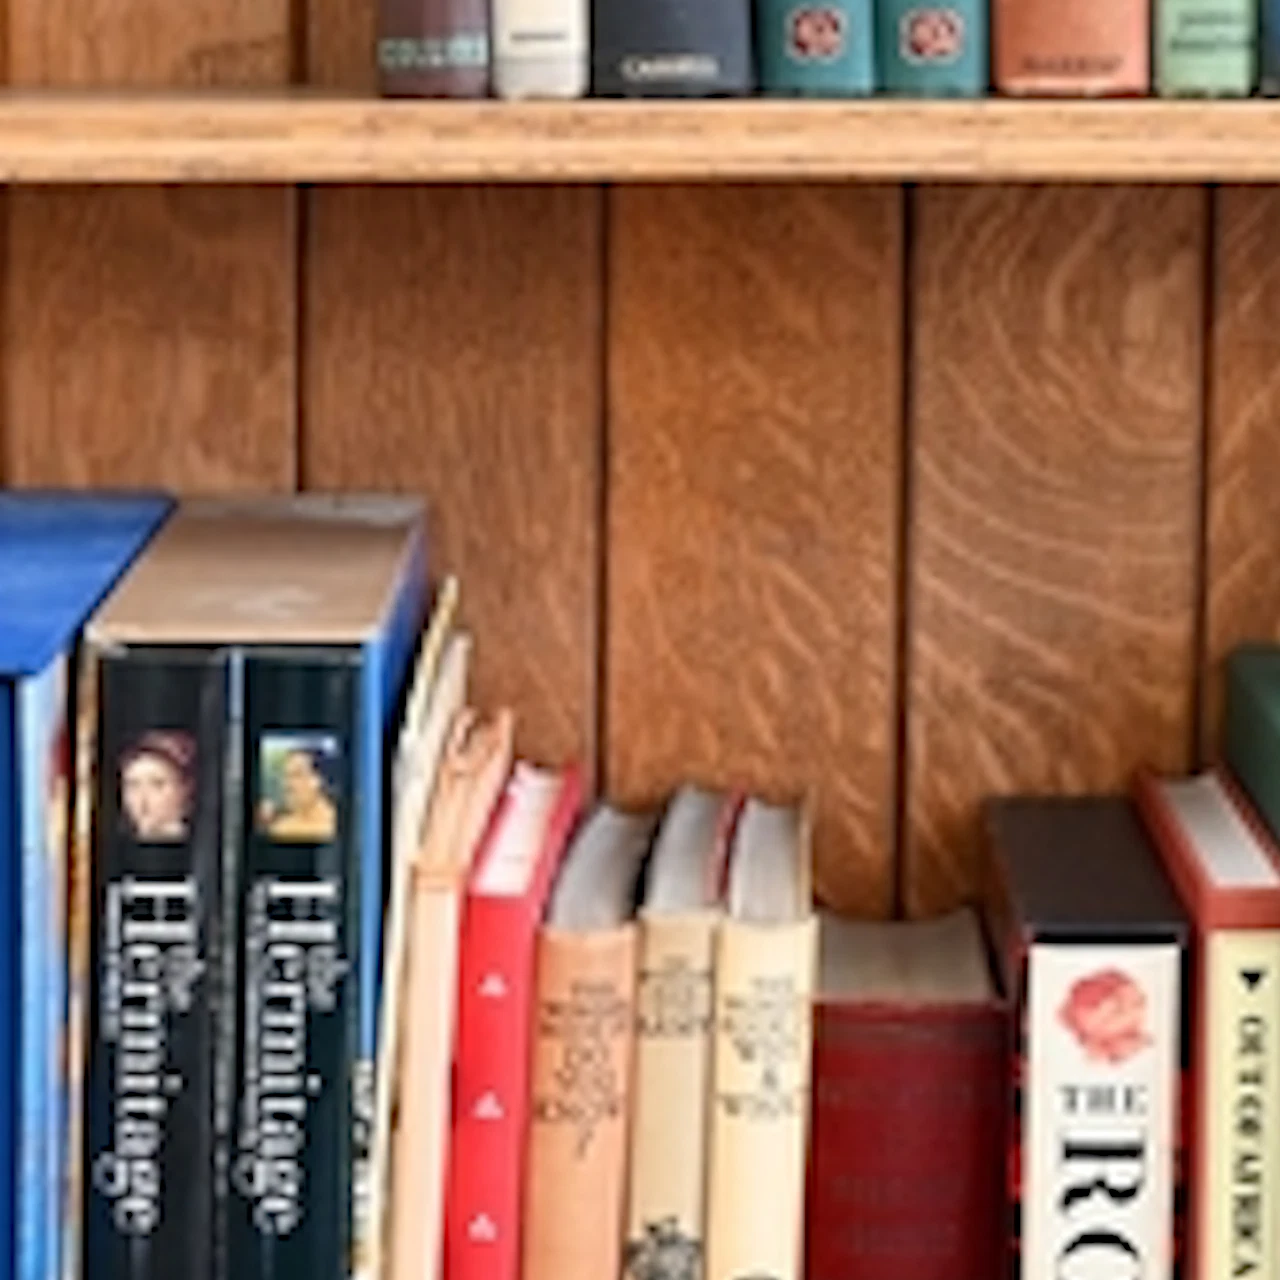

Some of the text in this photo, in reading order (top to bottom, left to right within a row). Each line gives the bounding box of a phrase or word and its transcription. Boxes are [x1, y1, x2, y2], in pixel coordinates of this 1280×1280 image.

[92, 879, 198, 1236] Hermitage
[232, 879, 339, 1236] Hermitage
[1059, 1084, 1150, 1115] THE
[1231, 1014, 1266, 1280] OUT OF AFRICA
